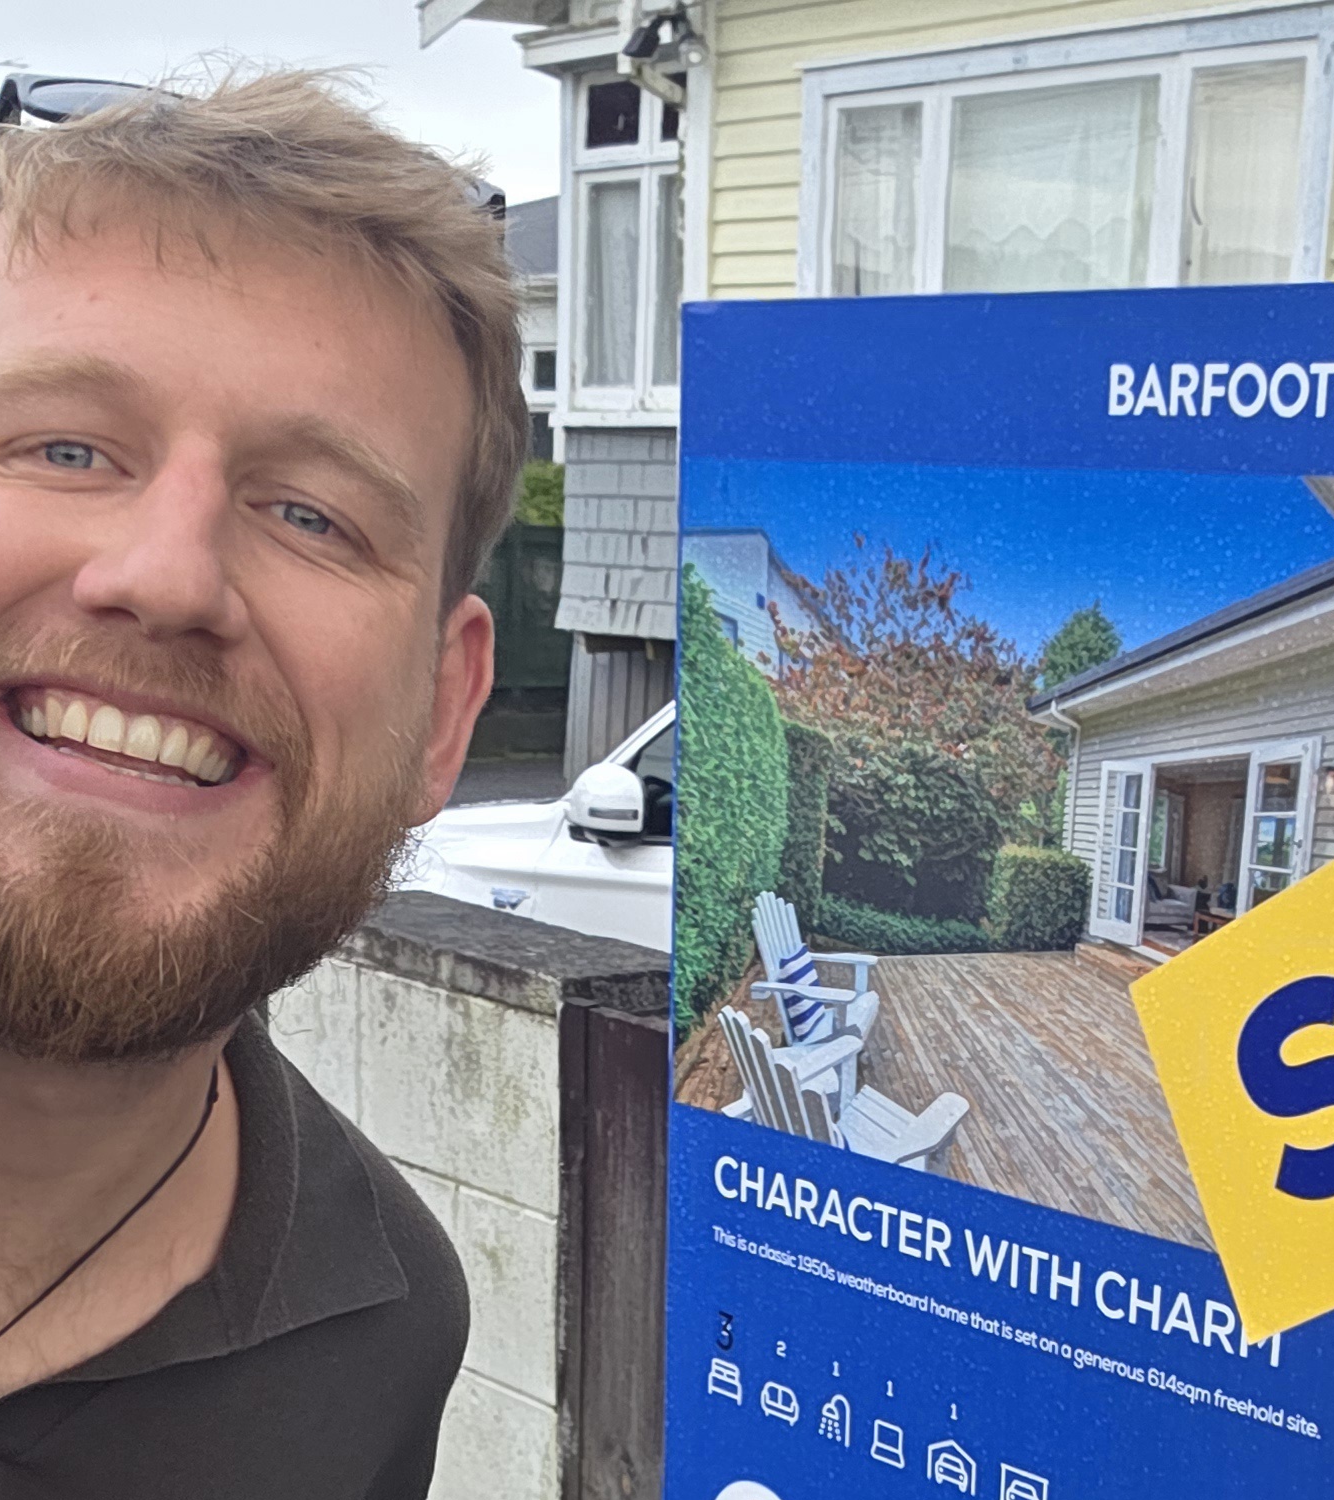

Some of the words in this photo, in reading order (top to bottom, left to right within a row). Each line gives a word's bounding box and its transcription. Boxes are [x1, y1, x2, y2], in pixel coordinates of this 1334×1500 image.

[714, 1156, 952, 1267] CHARACTER
[965, 1229, 1080, 1306] WITH
[712, 1224, 736, 1247] This
[737, 1234, 747, 1251] is
[748, 1243, 758, 1255] a
[759, 1242, 797, 1268] classic
[797, 1254, 836, 1281] 1950s
[836, 1270, 928, 1311] weatherboard
[929, 1298, 968, 1325] home
[970, 1312, 1000, 1336] that
[1001, 1322, 1013, 1340] is
[1015, 1329, 1038, 1349] set
[1039, 1337, 1059, 1355] on
[1061, 1346, 1072, 1359] a
[1074, 1348, 1145, 1382] generous
[1147, 1368, 1211, 1404] 614sqm
[1214, 1389, 1284, 1427] freehold
[1286, 1414, 1322, 1439] site.
[716, 1310, 734, 1350] 3
[776, 1340, 787, 1357] 2
[832, 1361, 840, 1377] 1
[886, 1380, 894, 1396] 1
[950, 1403, 958, 1420] 1
